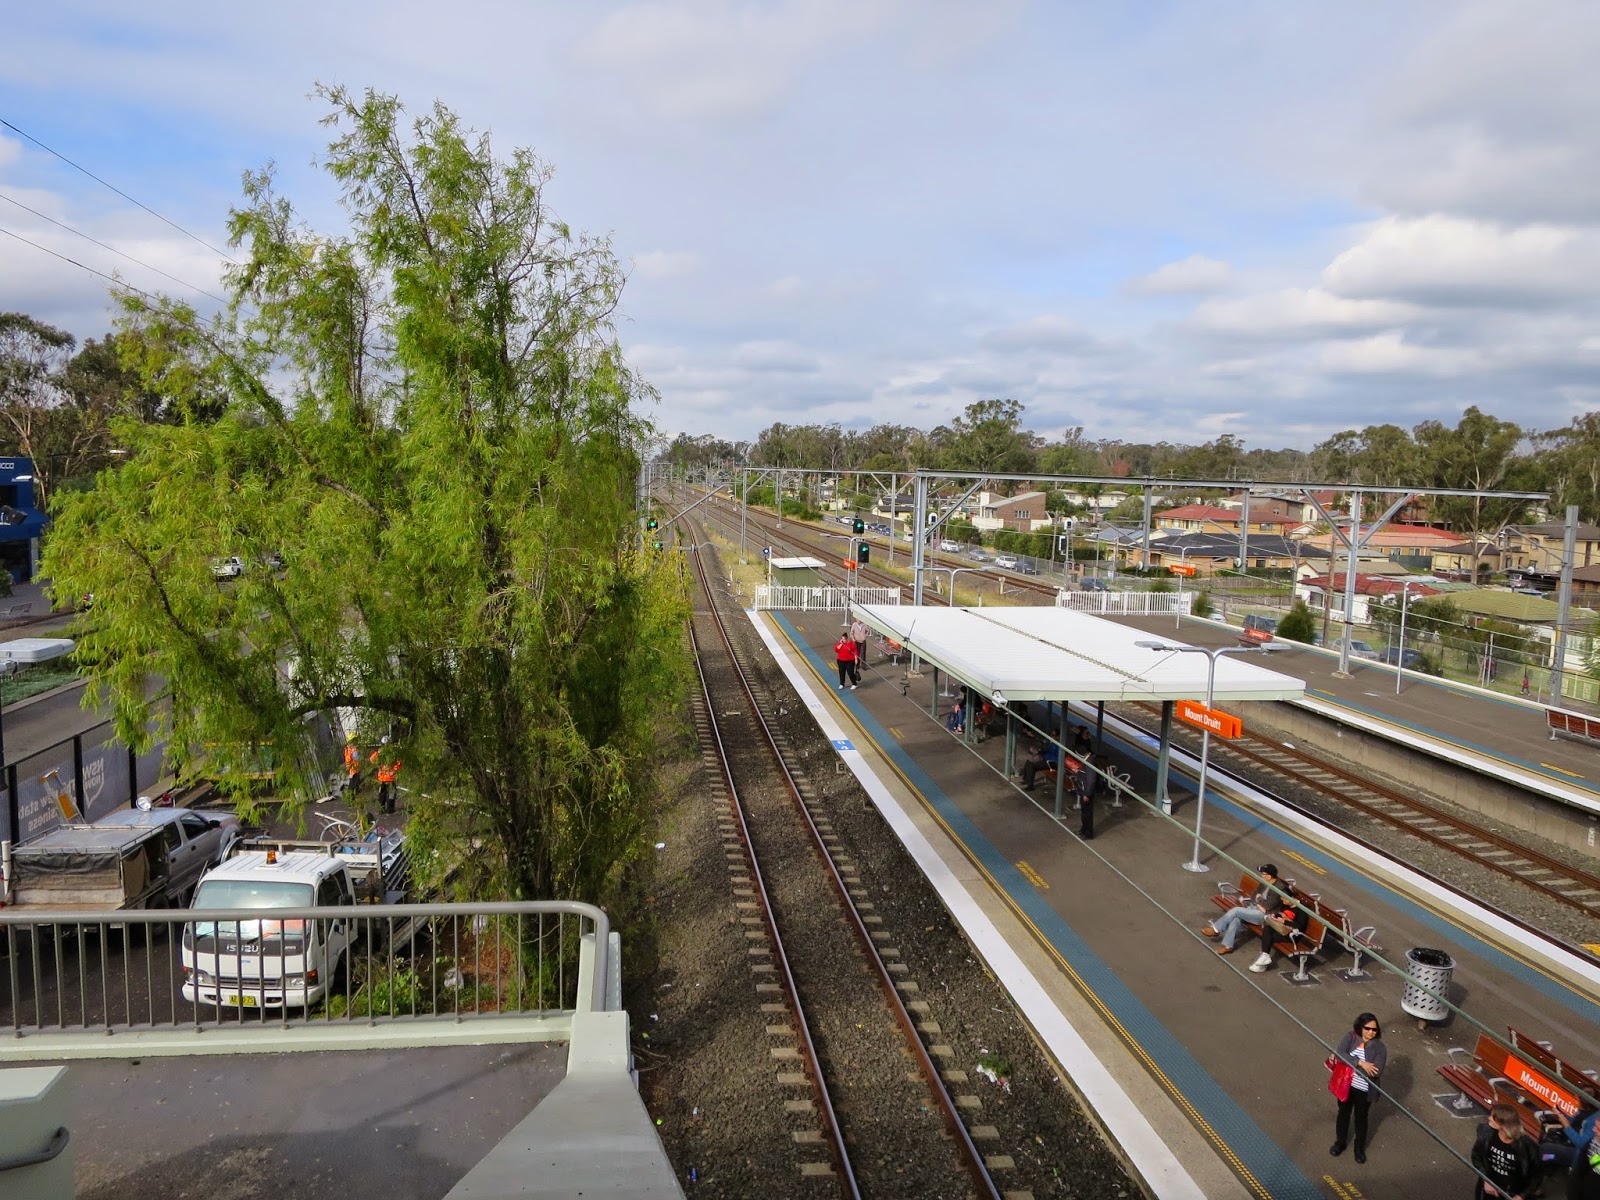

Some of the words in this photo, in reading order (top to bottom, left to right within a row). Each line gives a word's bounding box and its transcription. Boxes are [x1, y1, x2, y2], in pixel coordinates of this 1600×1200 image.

[1184, 706, 1203, 723] Mount
[1203, 713, 1222, 730] Druitt
[1520, 1070, 1550, 1098] Mount
[1490, 1145, 1505, 1157] TAKE
